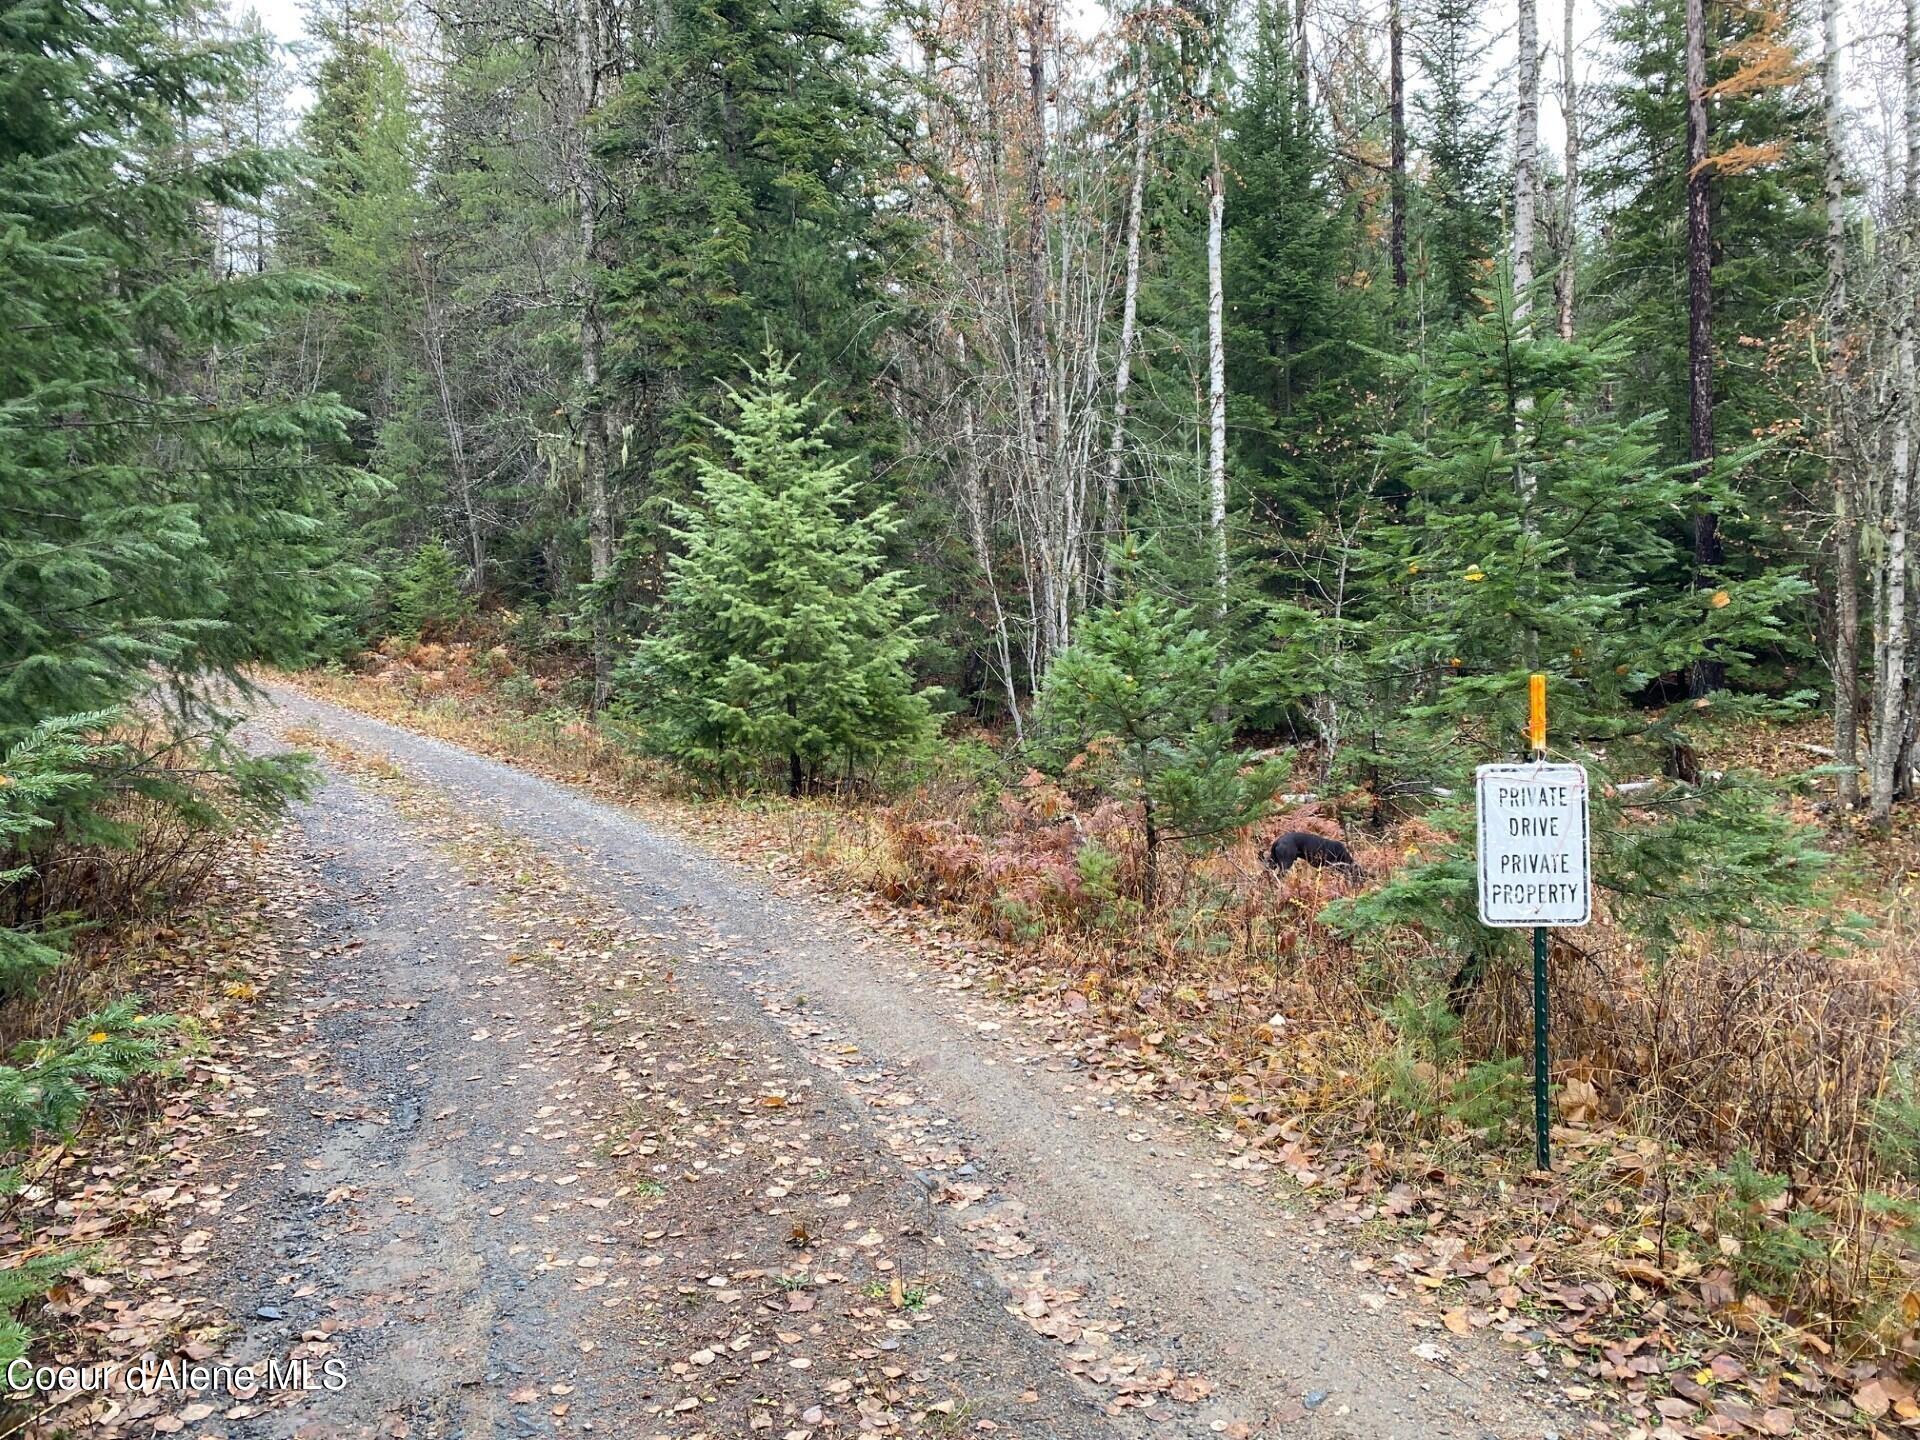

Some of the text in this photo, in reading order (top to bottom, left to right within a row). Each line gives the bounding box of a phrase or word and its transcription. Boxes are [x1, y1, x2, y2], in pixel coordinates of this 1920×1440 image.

[1499, 787, 1568, 807] PRIVATE
[1509, 817, 1559, 837] DRIVE
[1501, 853, 1569, 874] PRIVATE
[1492, 883, 1579, 905] PROPERTY
